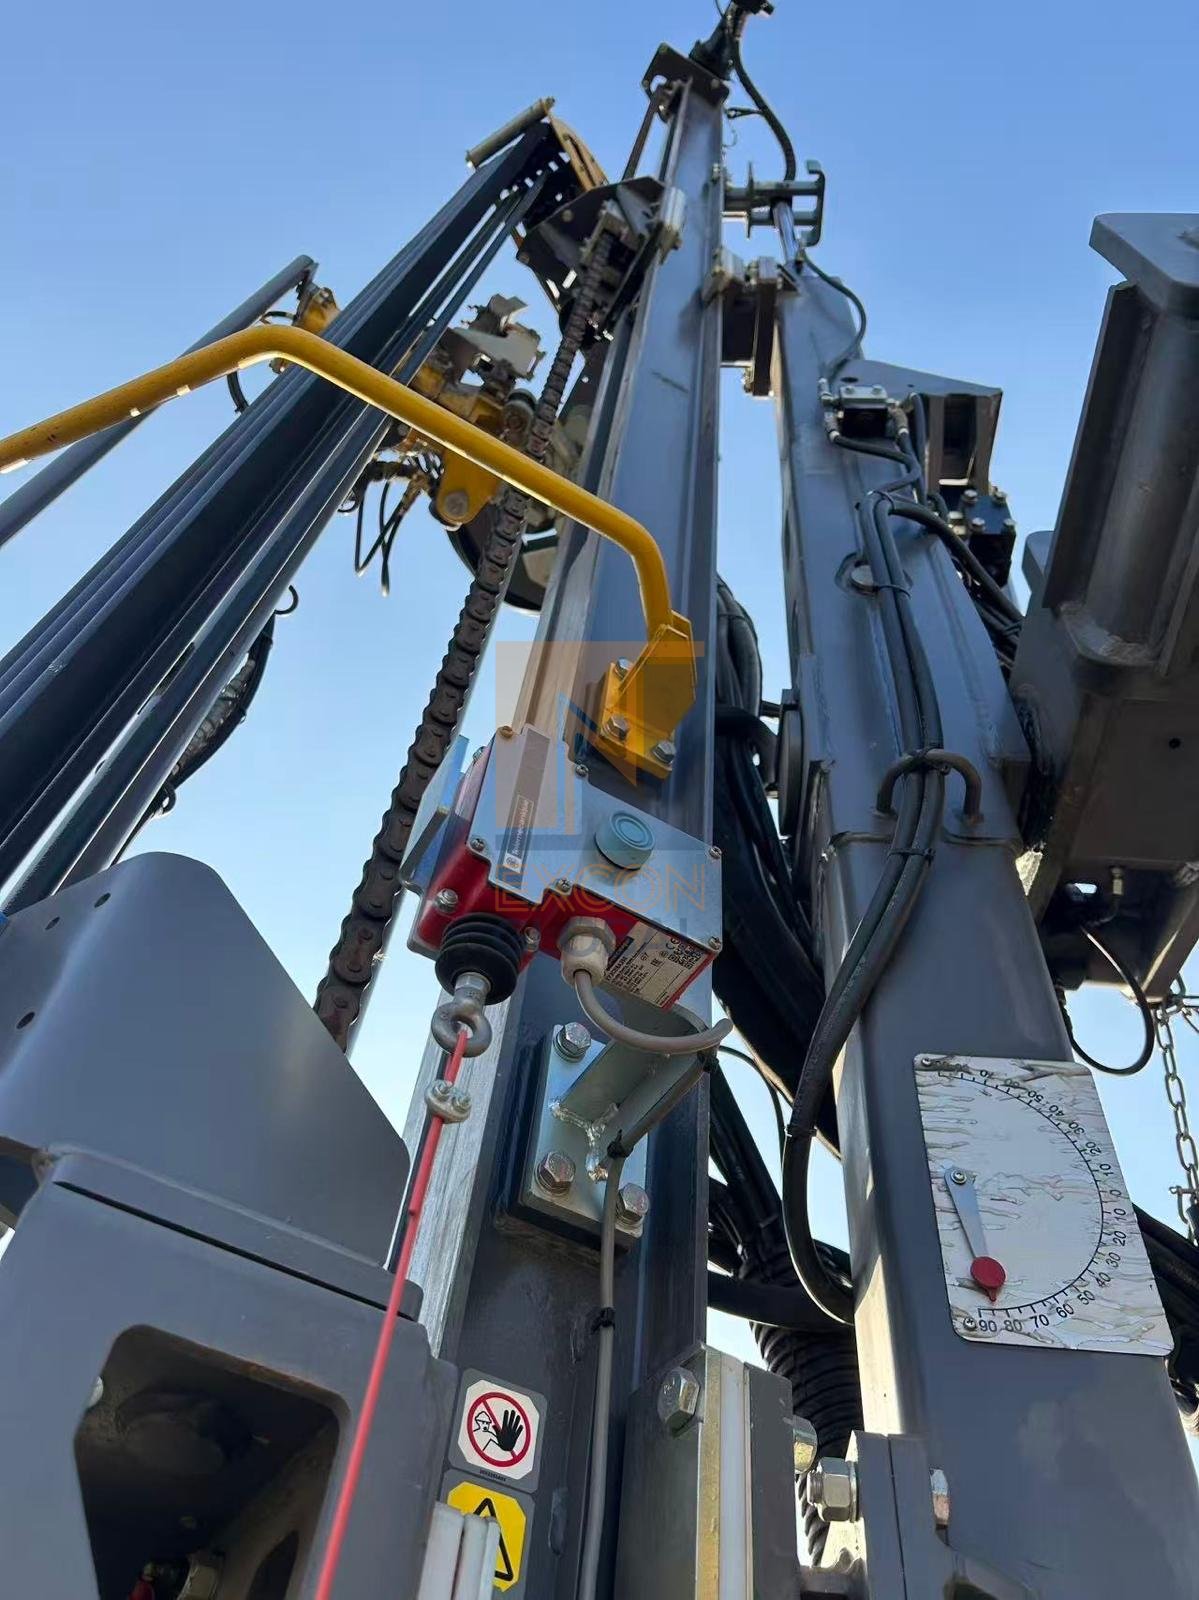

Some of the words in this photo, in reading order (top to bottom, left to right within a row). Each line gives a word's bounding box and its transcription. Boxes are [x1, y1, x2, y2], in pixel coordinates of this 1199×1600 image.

[1027, 1090, 1044, 1103] 50
[1048, 1104, 1065, 1117] 40
[1068, 1121, 1085, 1135] 30
[1085, 1141, 1102, 1155] 20
[1099, 1163, 1114, 1176] 10
[1113, 1208, 1127, 1221] 10
[1112, 1230, 1127, 1247] 20
[1105, 1252, 1121, 1268] 30
[1095, 1272, 1111, 1288] 40
[1076, 1290, 1095, 1305] 50
[1055, 1303, 1074, 1318] 60
[978, 1319, 998, 1332] 90
[1003, 1319, 1023, 1332] 80
[1029, 1314, 1050, 1328] 70
